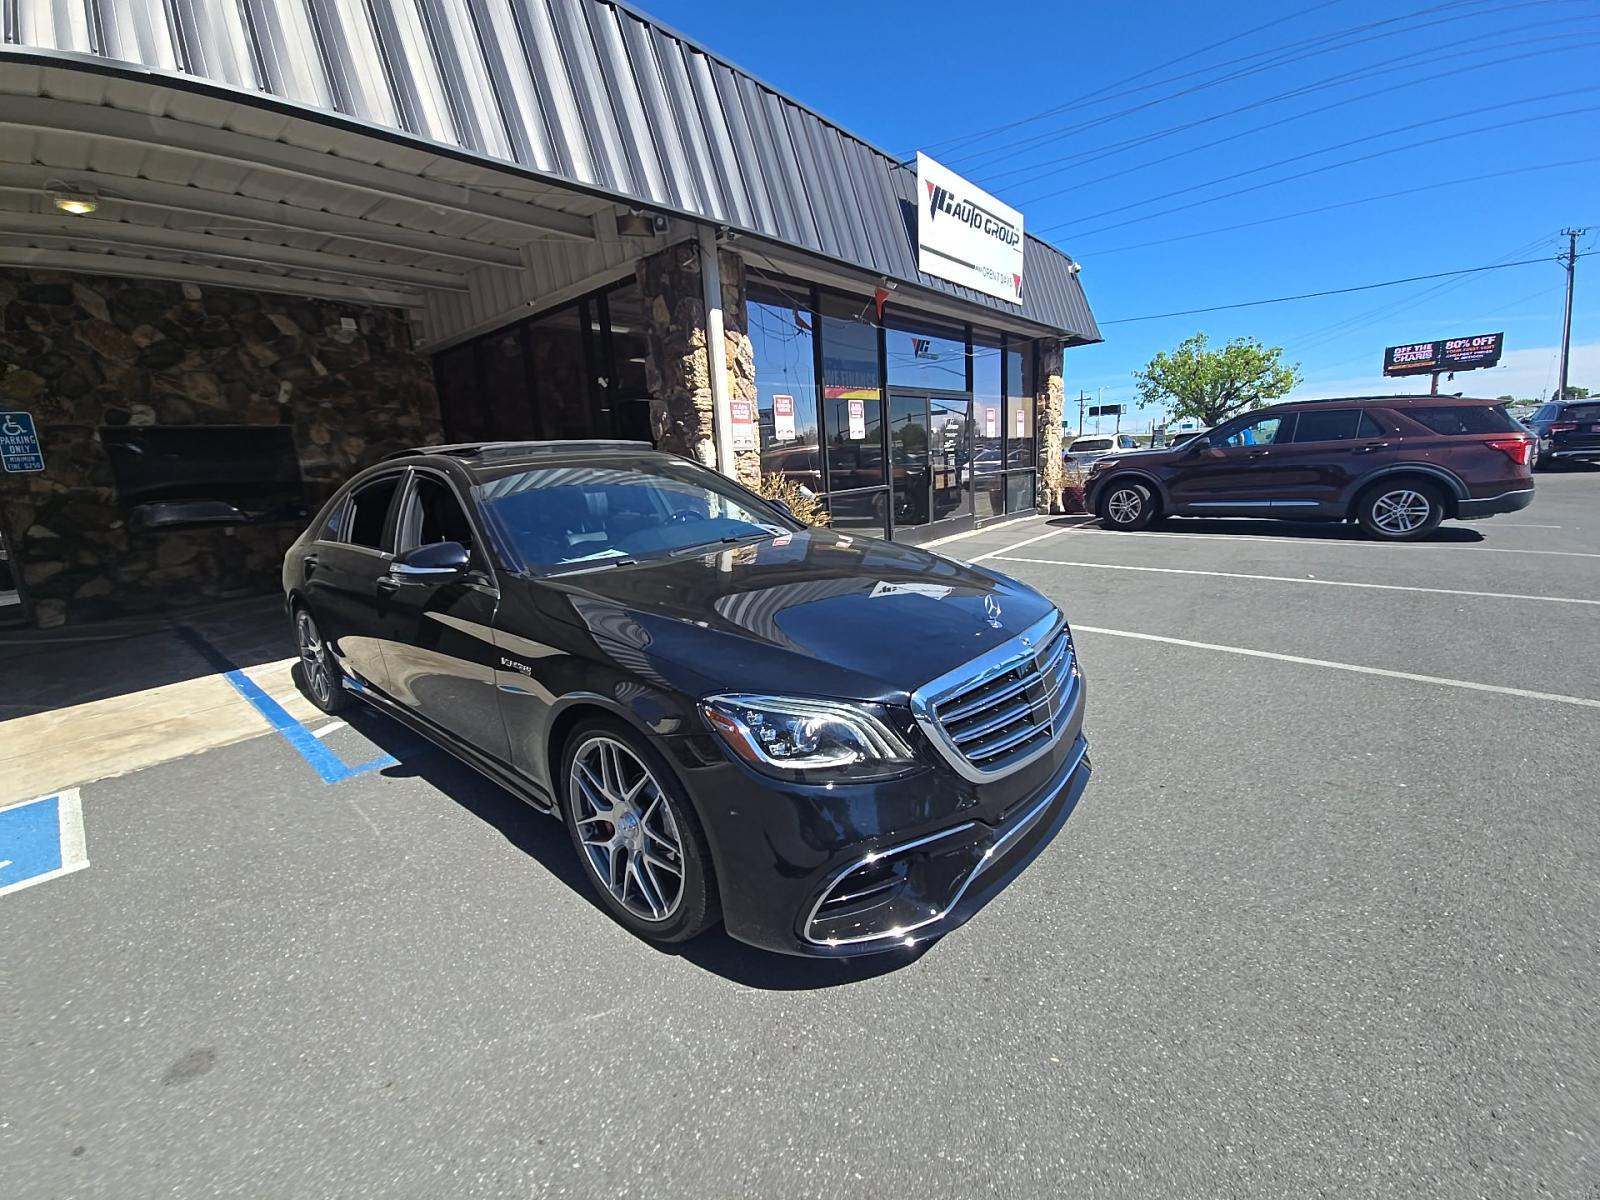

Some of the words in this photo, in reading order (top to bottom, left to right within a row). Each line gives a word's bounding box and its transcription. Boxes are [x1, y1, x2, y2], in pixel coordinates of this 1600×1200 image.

[952, 201, 982, 228] AUTO
[984, 218, 1019, 246] GROUP
[1446, 339, 1470, 349] 80%
[1473, 336, 1496, 346] OFF
[1394, 346, 1413, 354] OFF
[0, 435, 36, 445] PARKING
[9, 445, 30, 454] ONLY
